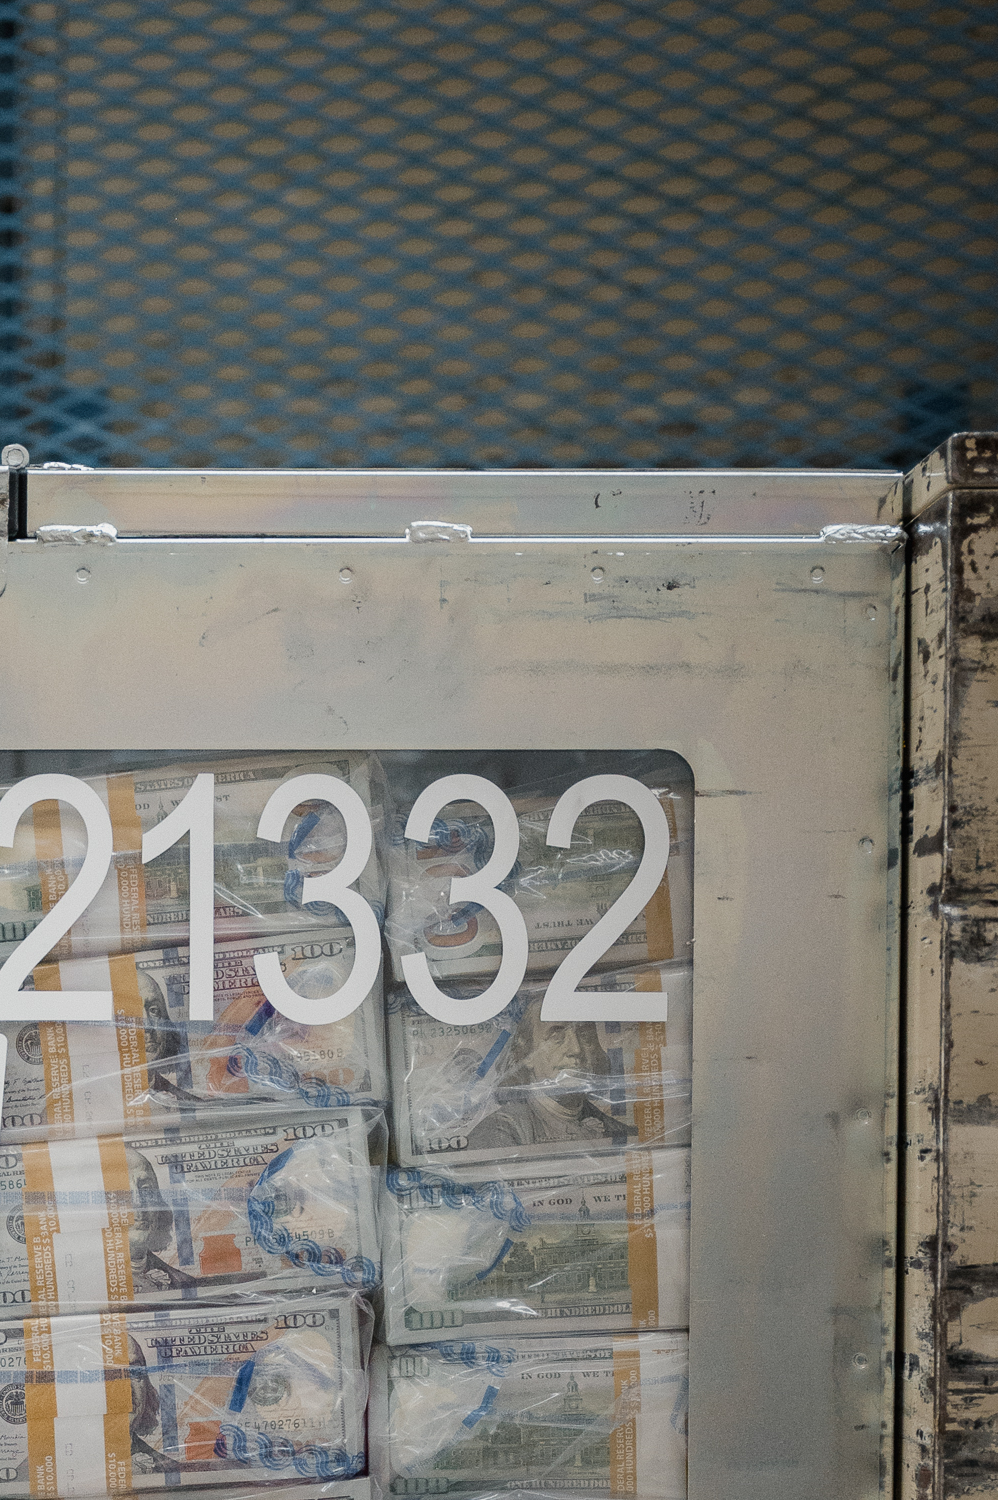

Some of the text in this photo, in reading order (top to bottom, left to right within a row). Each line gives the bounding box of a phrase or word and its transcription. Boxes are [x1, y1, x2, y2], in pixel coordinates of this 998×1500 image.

[290, 942, 343, 961] 100
[282, 1123, 335, 1140] 100
[532, 1197, 573, 1208] IN GOD
[592, 1194, 611, 1204] WE
[274, 1312, 326, 1330] 100
[113, 1328, 123, 1357] BANK
[520, 1371, 562, 1380] IN GOD
[581, 1370, 600, 1379] WE
[36, 1465, 46, 1491] BANK
